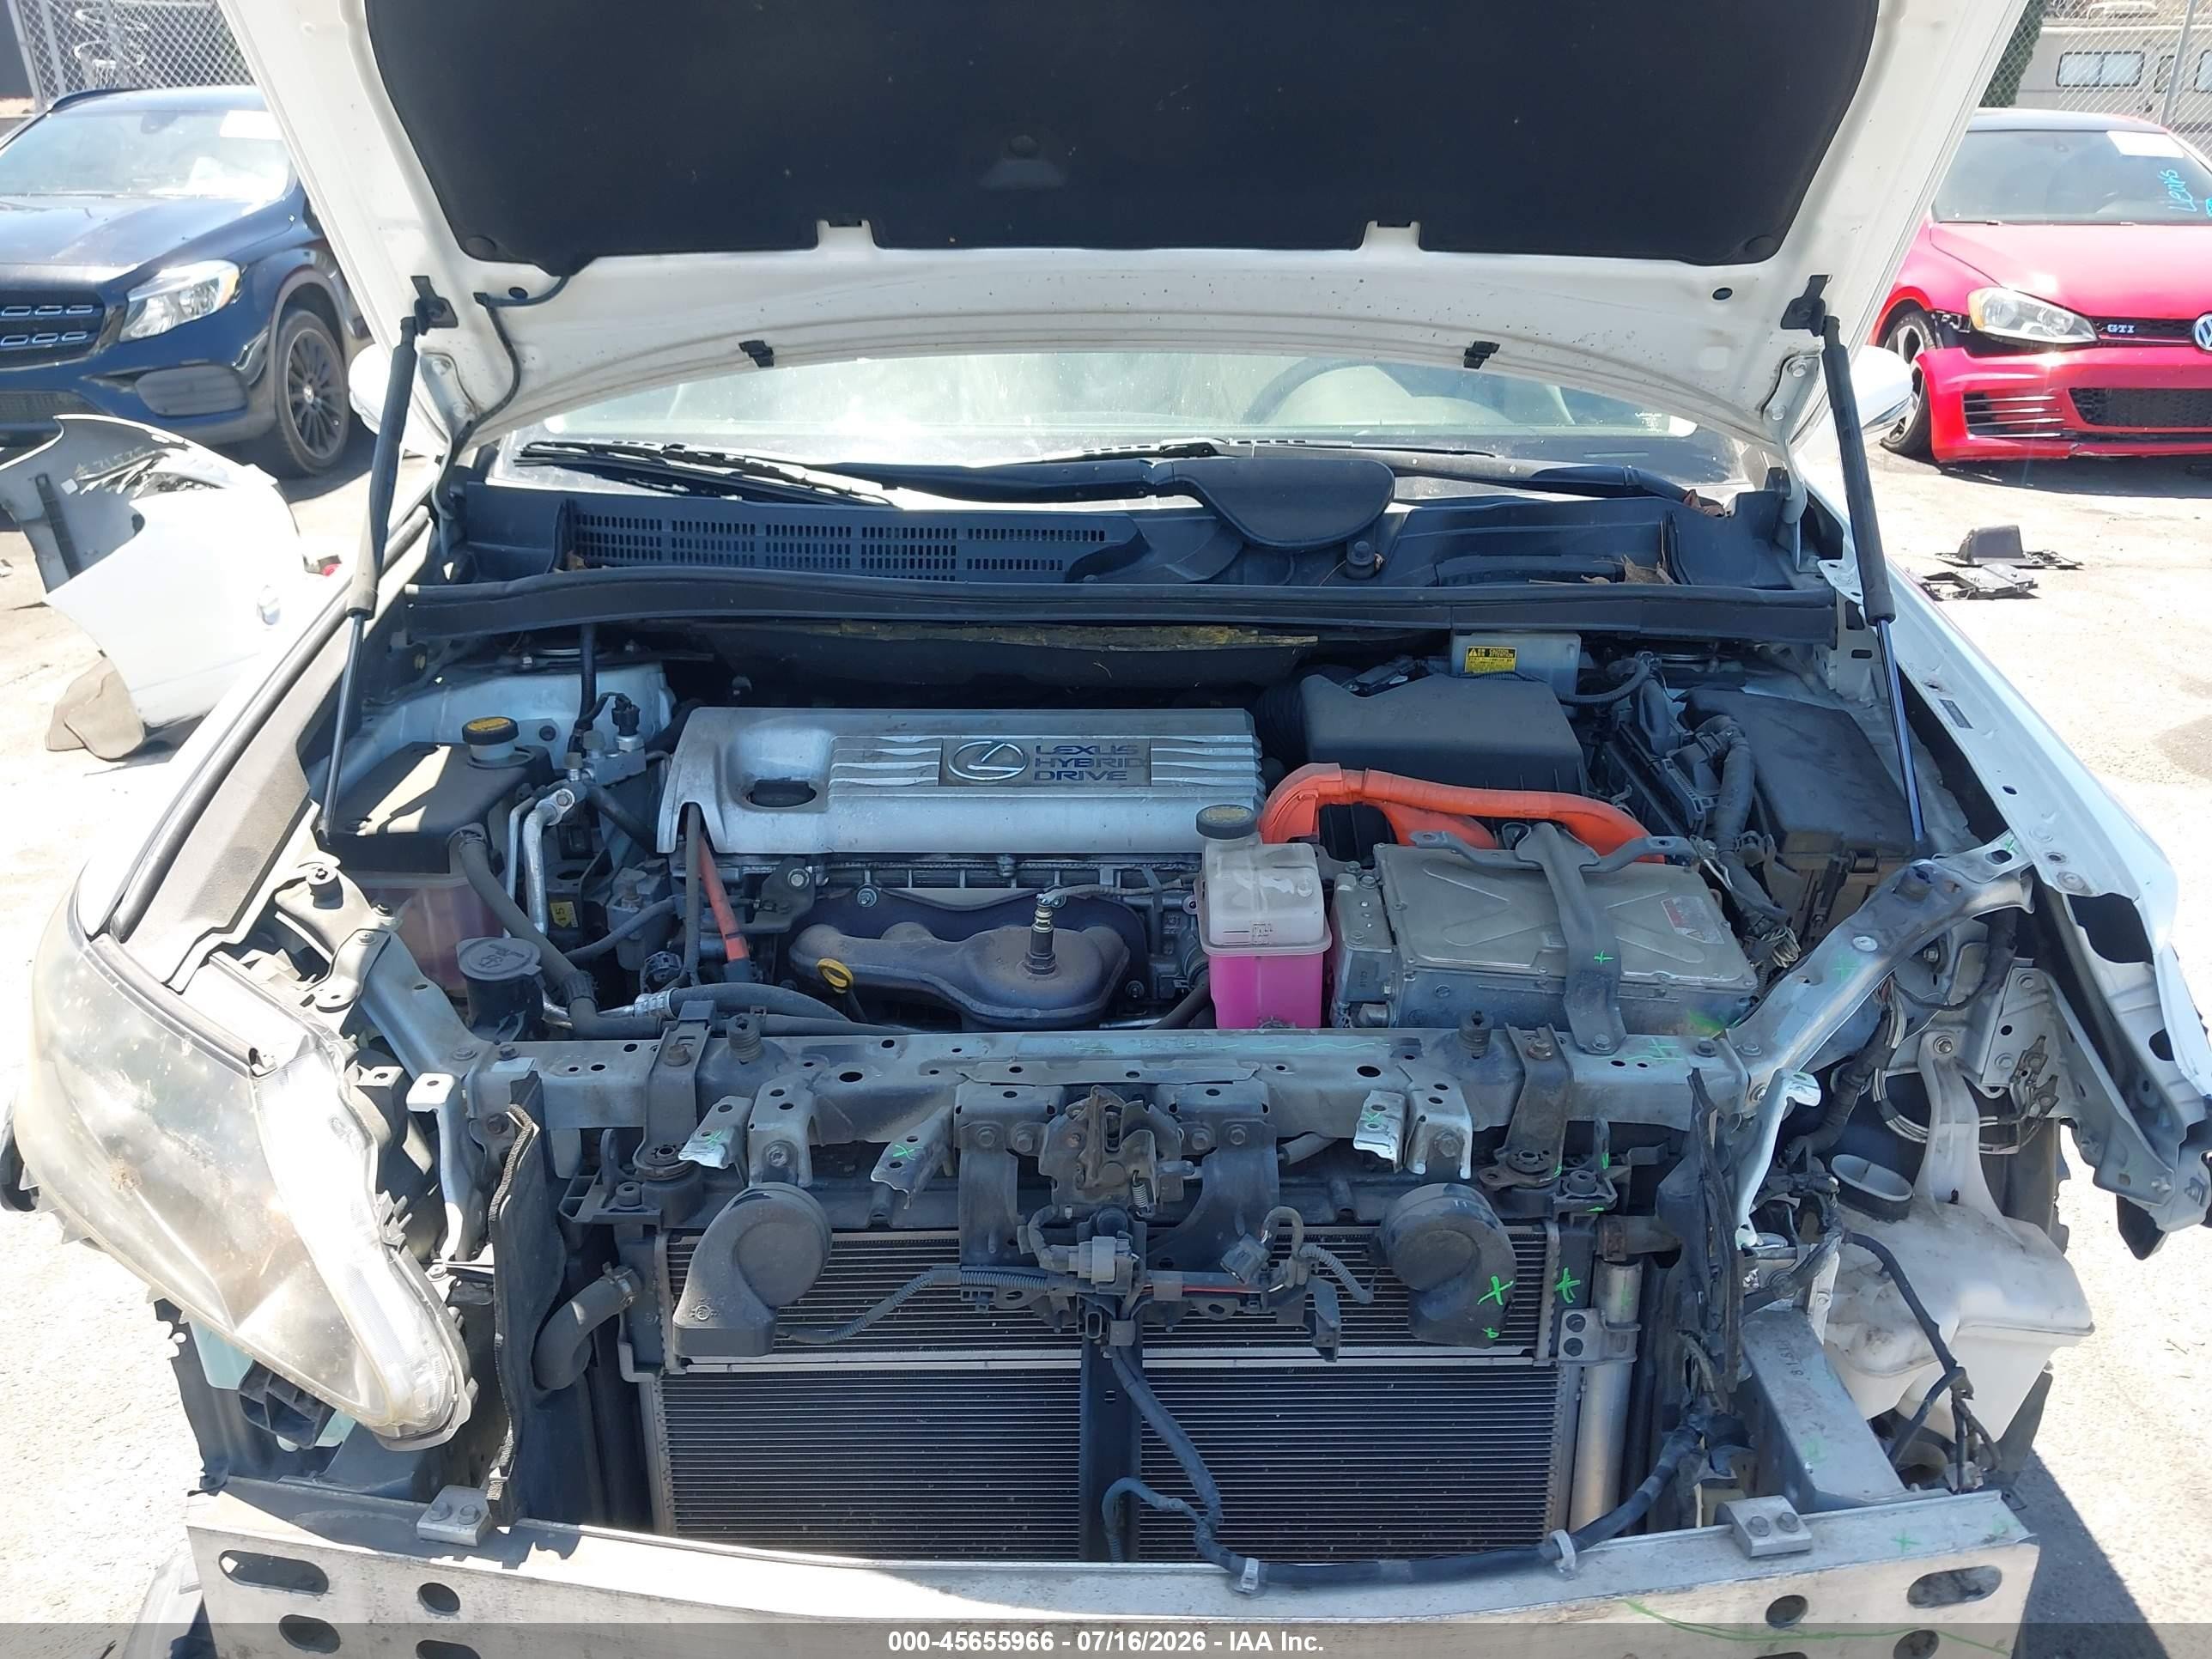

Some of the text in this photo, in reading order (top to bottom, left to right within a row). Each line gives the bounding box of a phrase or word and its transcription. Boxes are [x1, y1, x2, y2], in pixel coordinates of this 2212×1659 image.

[2106, 324, 2135, 333] GTI
[1036, 744, 1139, 755] LEXUS
[1035, 757, 1147, 768] HYBRID
[1034, 770, 1127, 781] DRIVE
